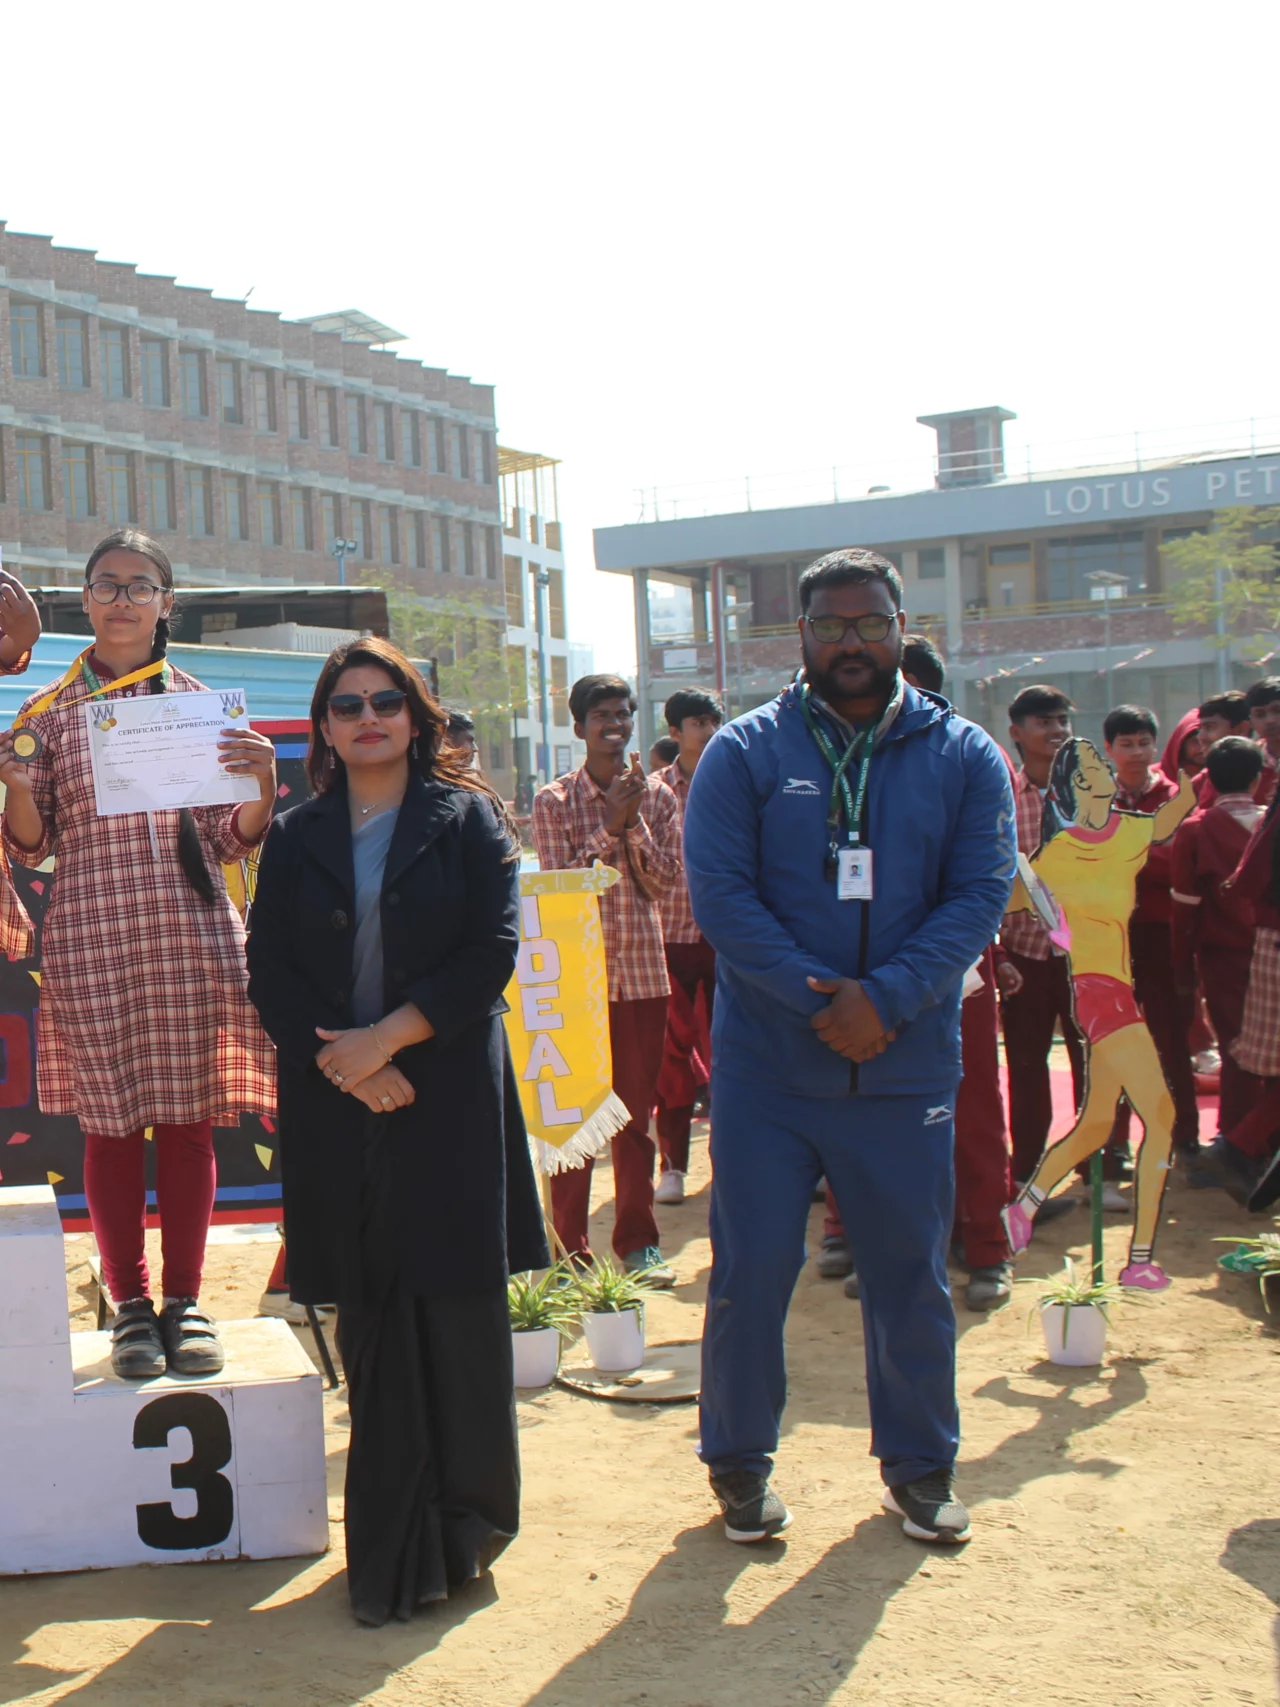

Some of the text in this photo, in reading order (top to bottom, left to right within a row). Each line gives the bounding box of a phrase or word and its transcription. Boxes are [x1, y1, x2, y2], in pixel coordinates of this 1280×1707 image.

[1045, 466, 1280, 516] LOTUS PET
[118, 726, 163, 736] CERTIFICATE
[176, 720, 225, 730] APPRECIATION
[853, 758, 869, 821] LOTUS PETAL FOUNDATION
[516, 895, 583, 1127] IDEAL
[133, 1391, 234, 1550] 3
